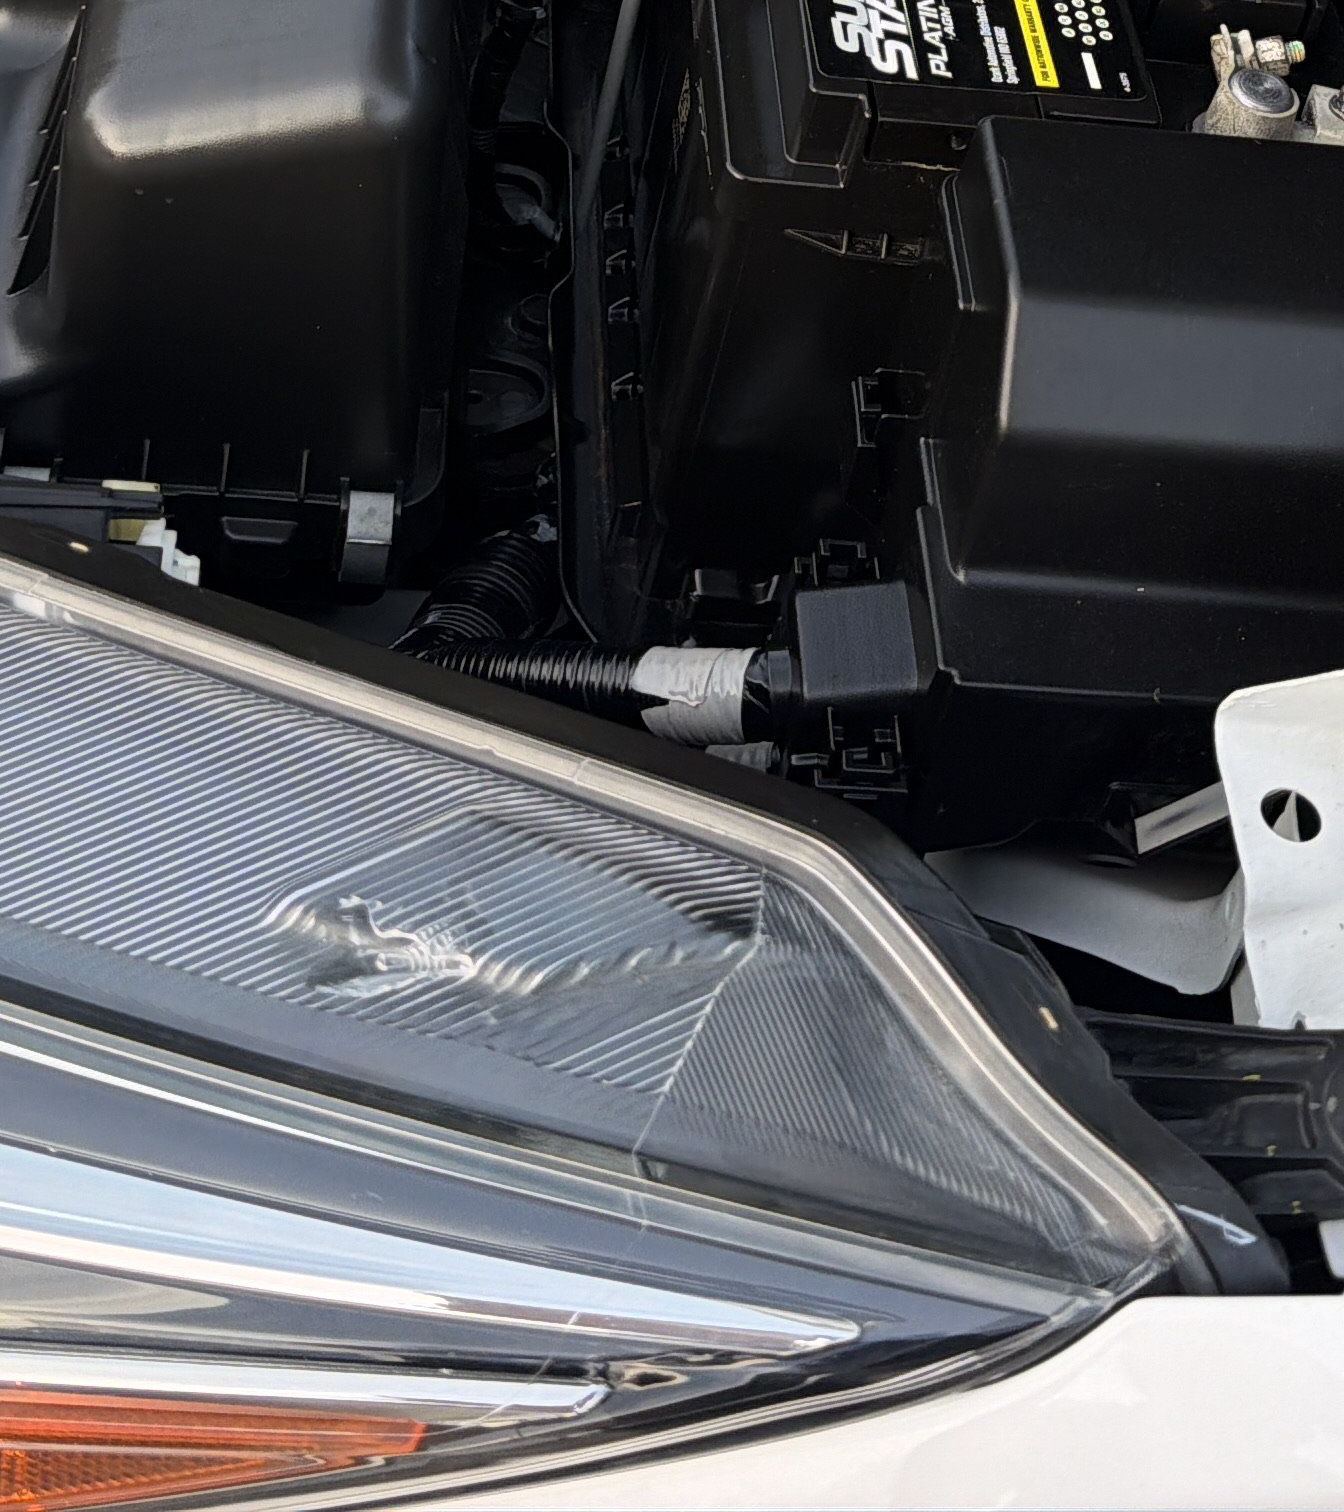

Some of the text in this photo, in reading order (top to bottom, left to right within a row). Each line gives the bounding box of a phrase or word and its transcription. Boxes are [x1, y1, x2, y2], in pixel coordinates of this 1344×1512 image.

[938, 5, 956, 36] AGM
[1023, 3, 1038, 33] WARRANTY
[1030, 34, 1047, 68] NATIONWIDE
[1039, 70, 1050, 81] FOR
